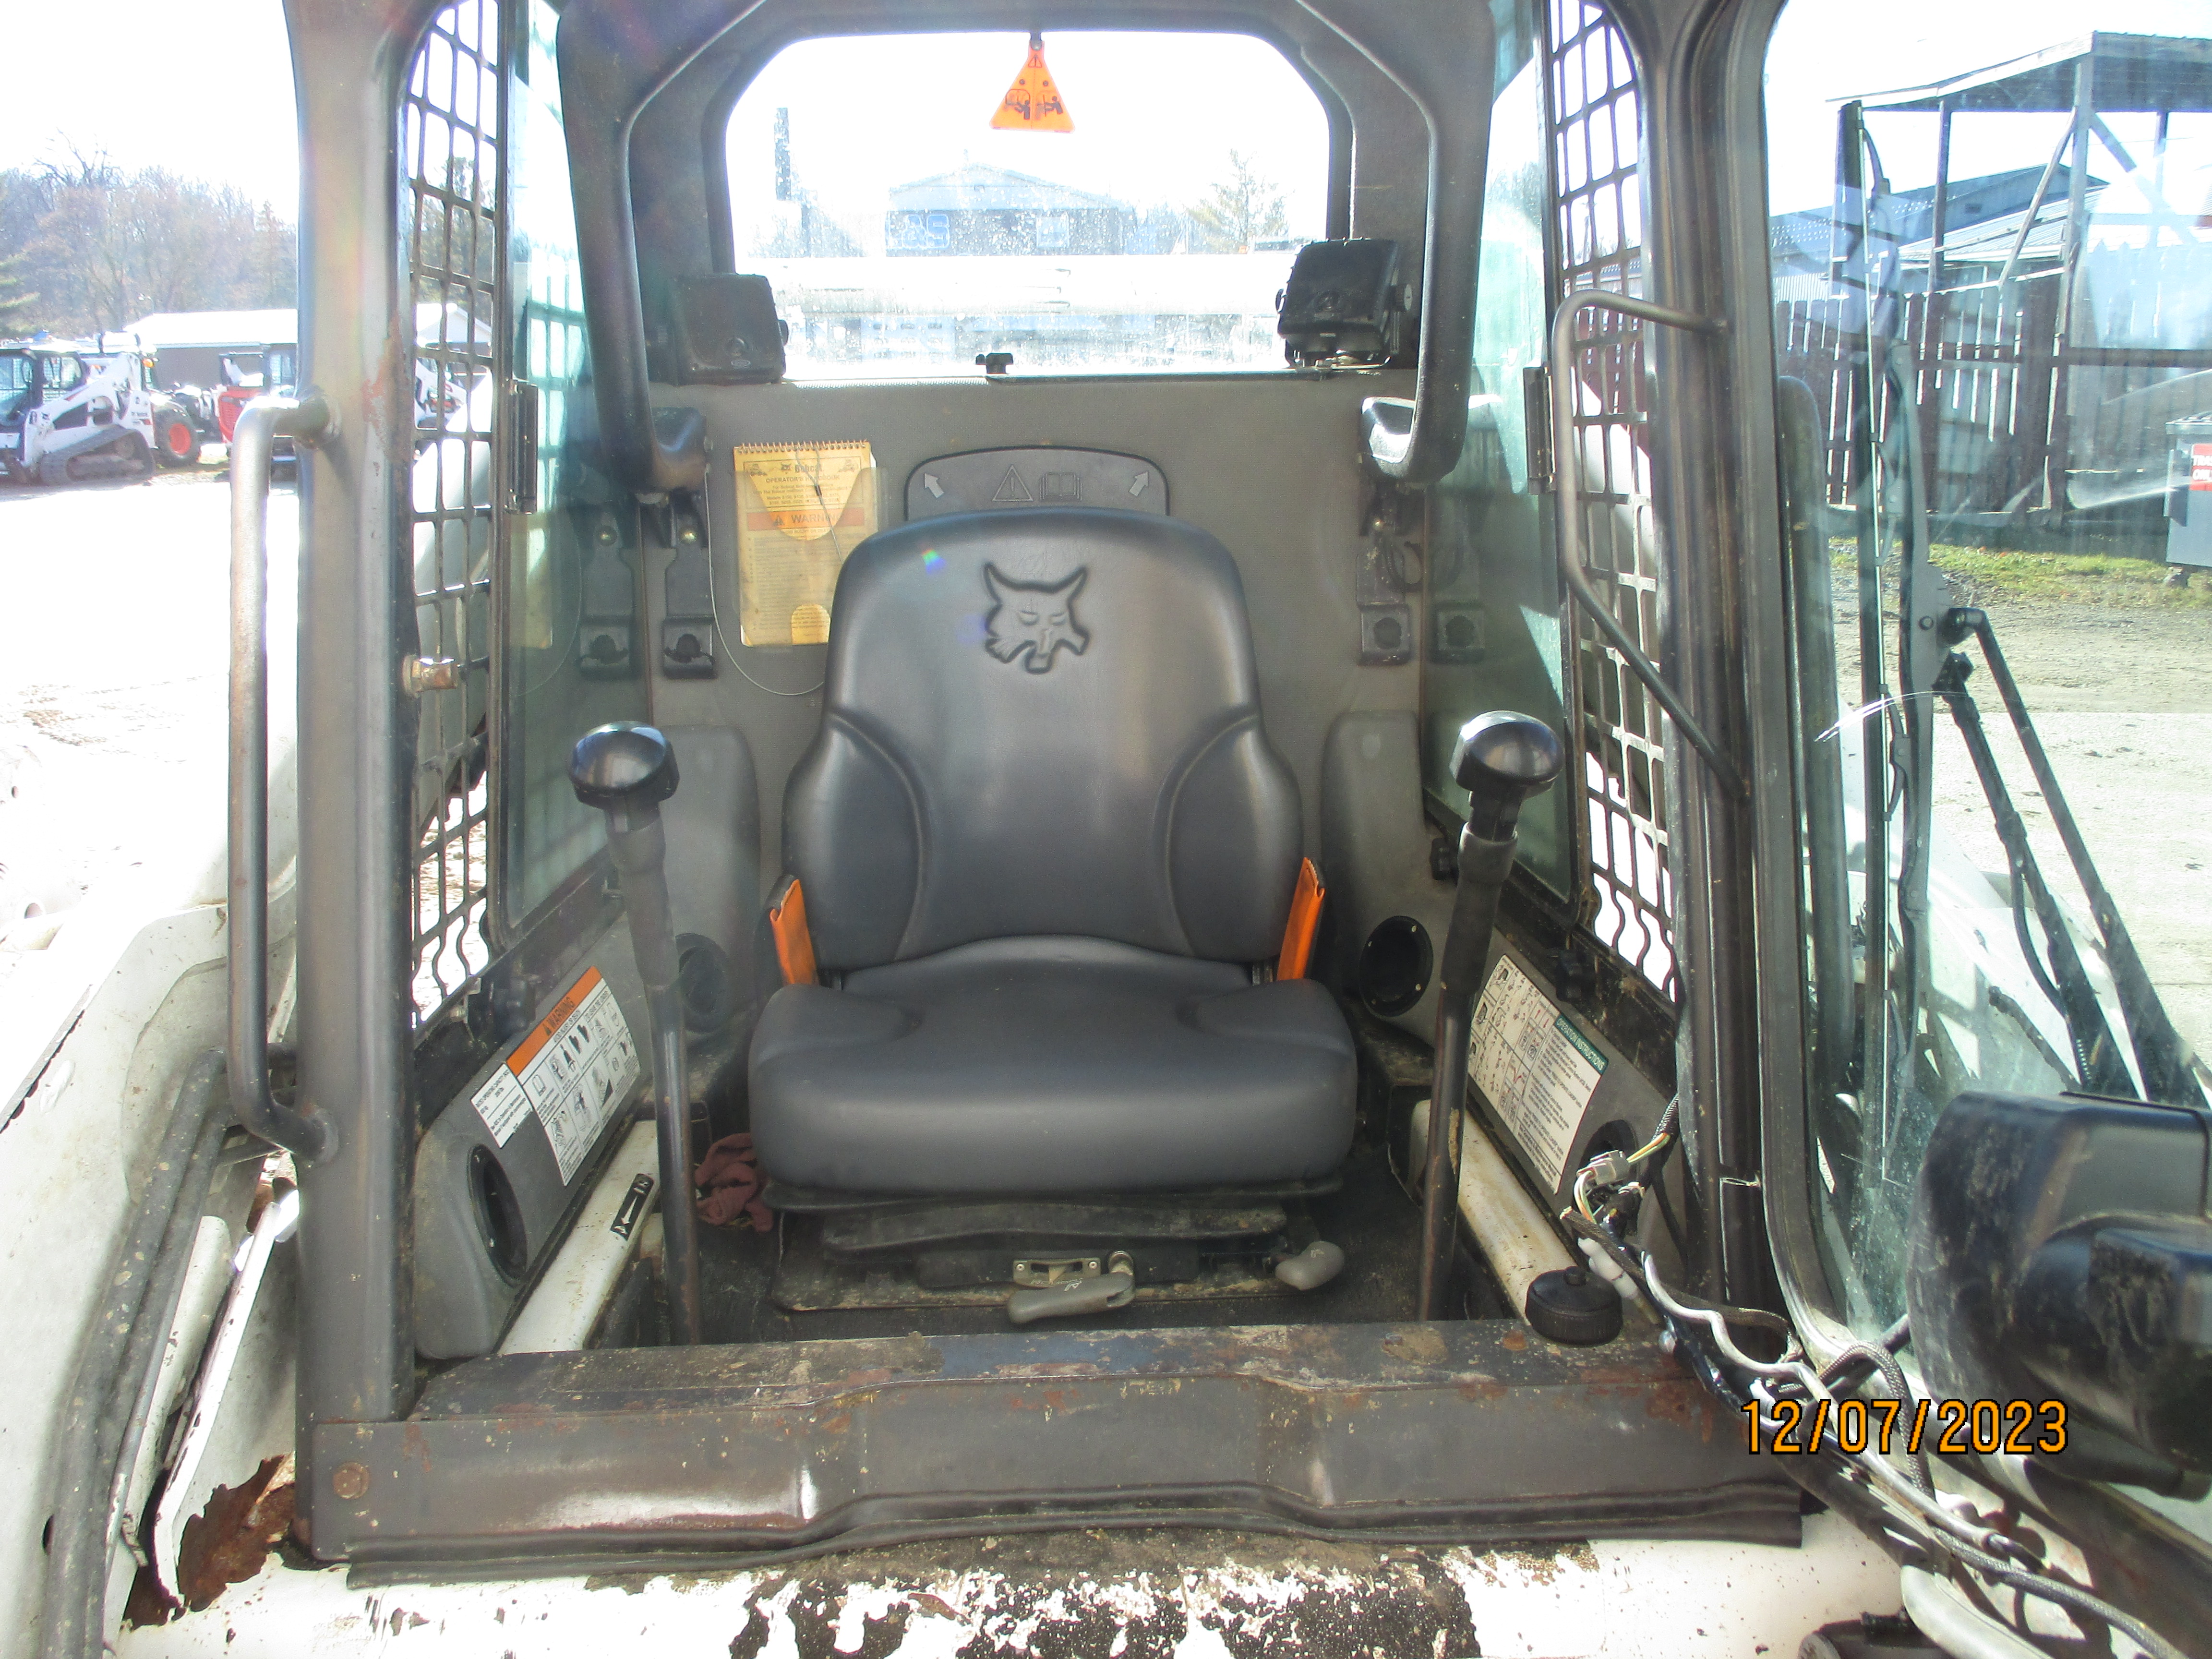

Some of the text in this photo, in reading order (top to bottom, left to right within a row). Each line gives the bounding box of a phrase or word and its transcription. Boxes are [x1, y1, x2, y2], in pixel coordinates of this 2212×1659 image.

[2194, 469, 2212, 480] ONL
[546, 996, 576, 1029] WARNING
[1556, 1017, 1579, 1043] OPERATION
[1575, 1037, 1605, 1070] INSTRUCTIONS
